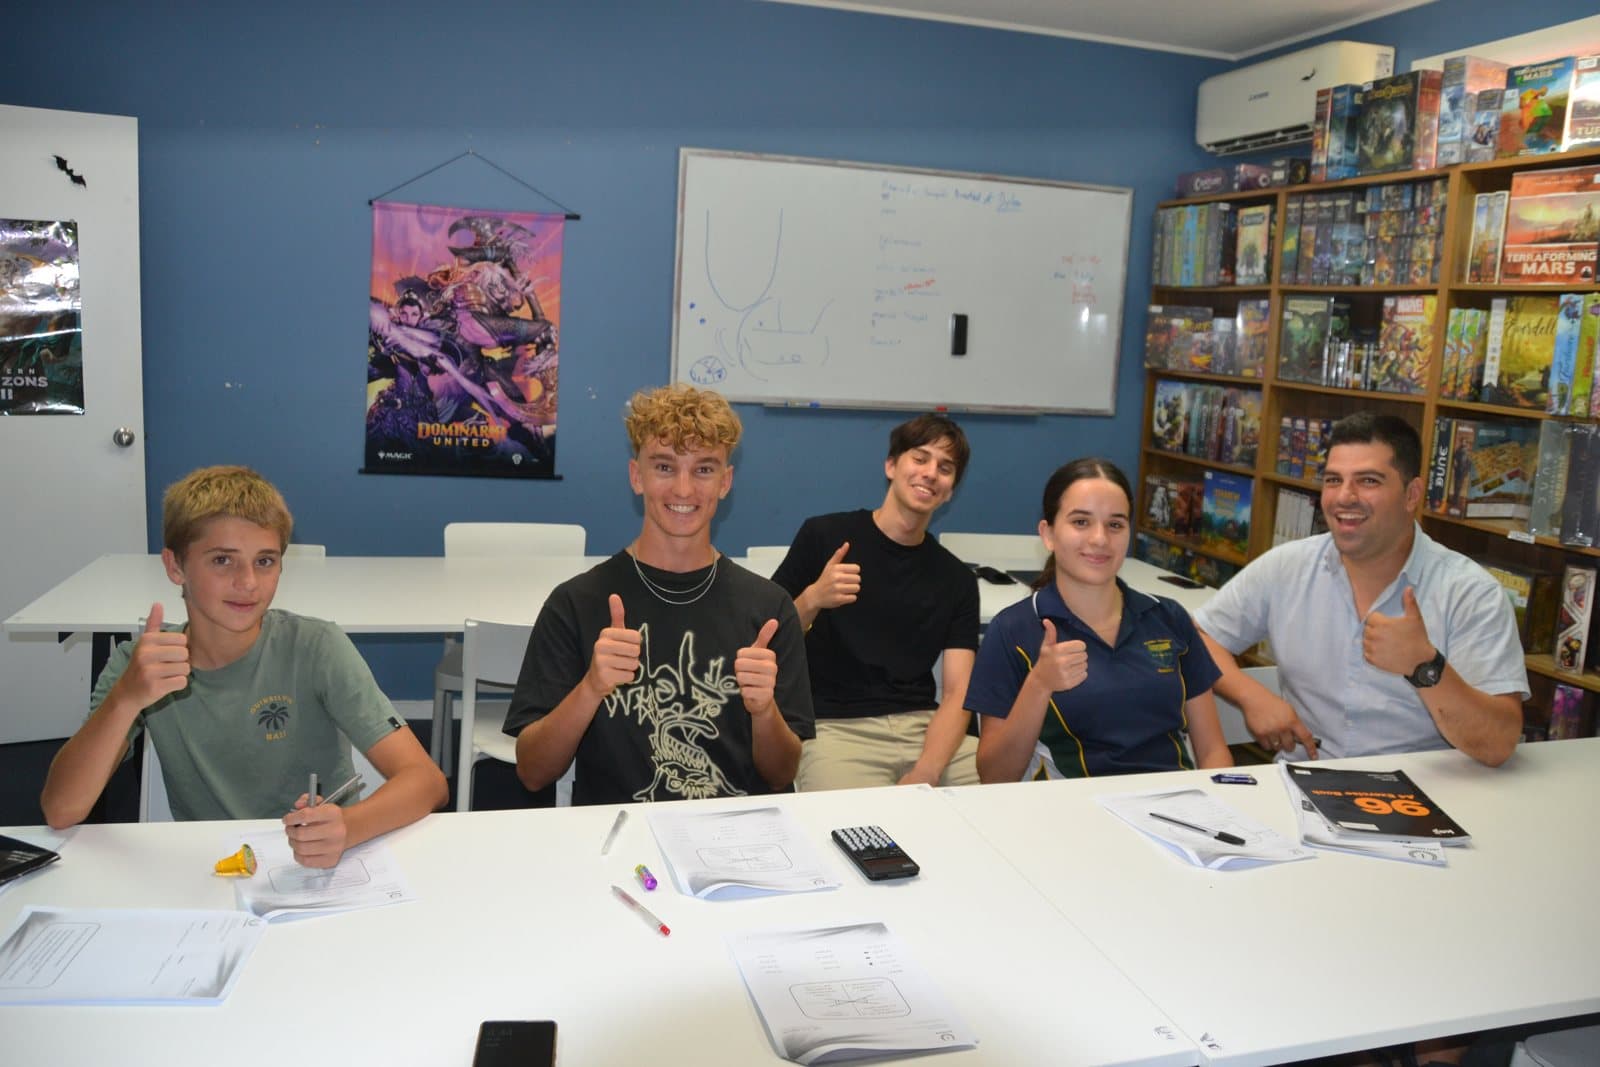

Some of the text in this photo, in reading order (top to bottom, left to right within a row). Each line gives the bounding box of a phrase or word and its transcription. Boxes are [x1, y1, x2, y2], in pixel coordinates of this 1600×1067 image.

[1506, 249, 1598, 263] TERRAFORMING
[1521, 262, 1576, 275] MARS
[1, 376, 49, 388] ZONS
[433, 437, 490, 447] UNITED
[385, 451, 413, 460] MAGIC
[1434, 446, 1449, 487] DUNE
[1311, 789, 1343, 797] Book
[1353, 796, 1431, 817] 96
